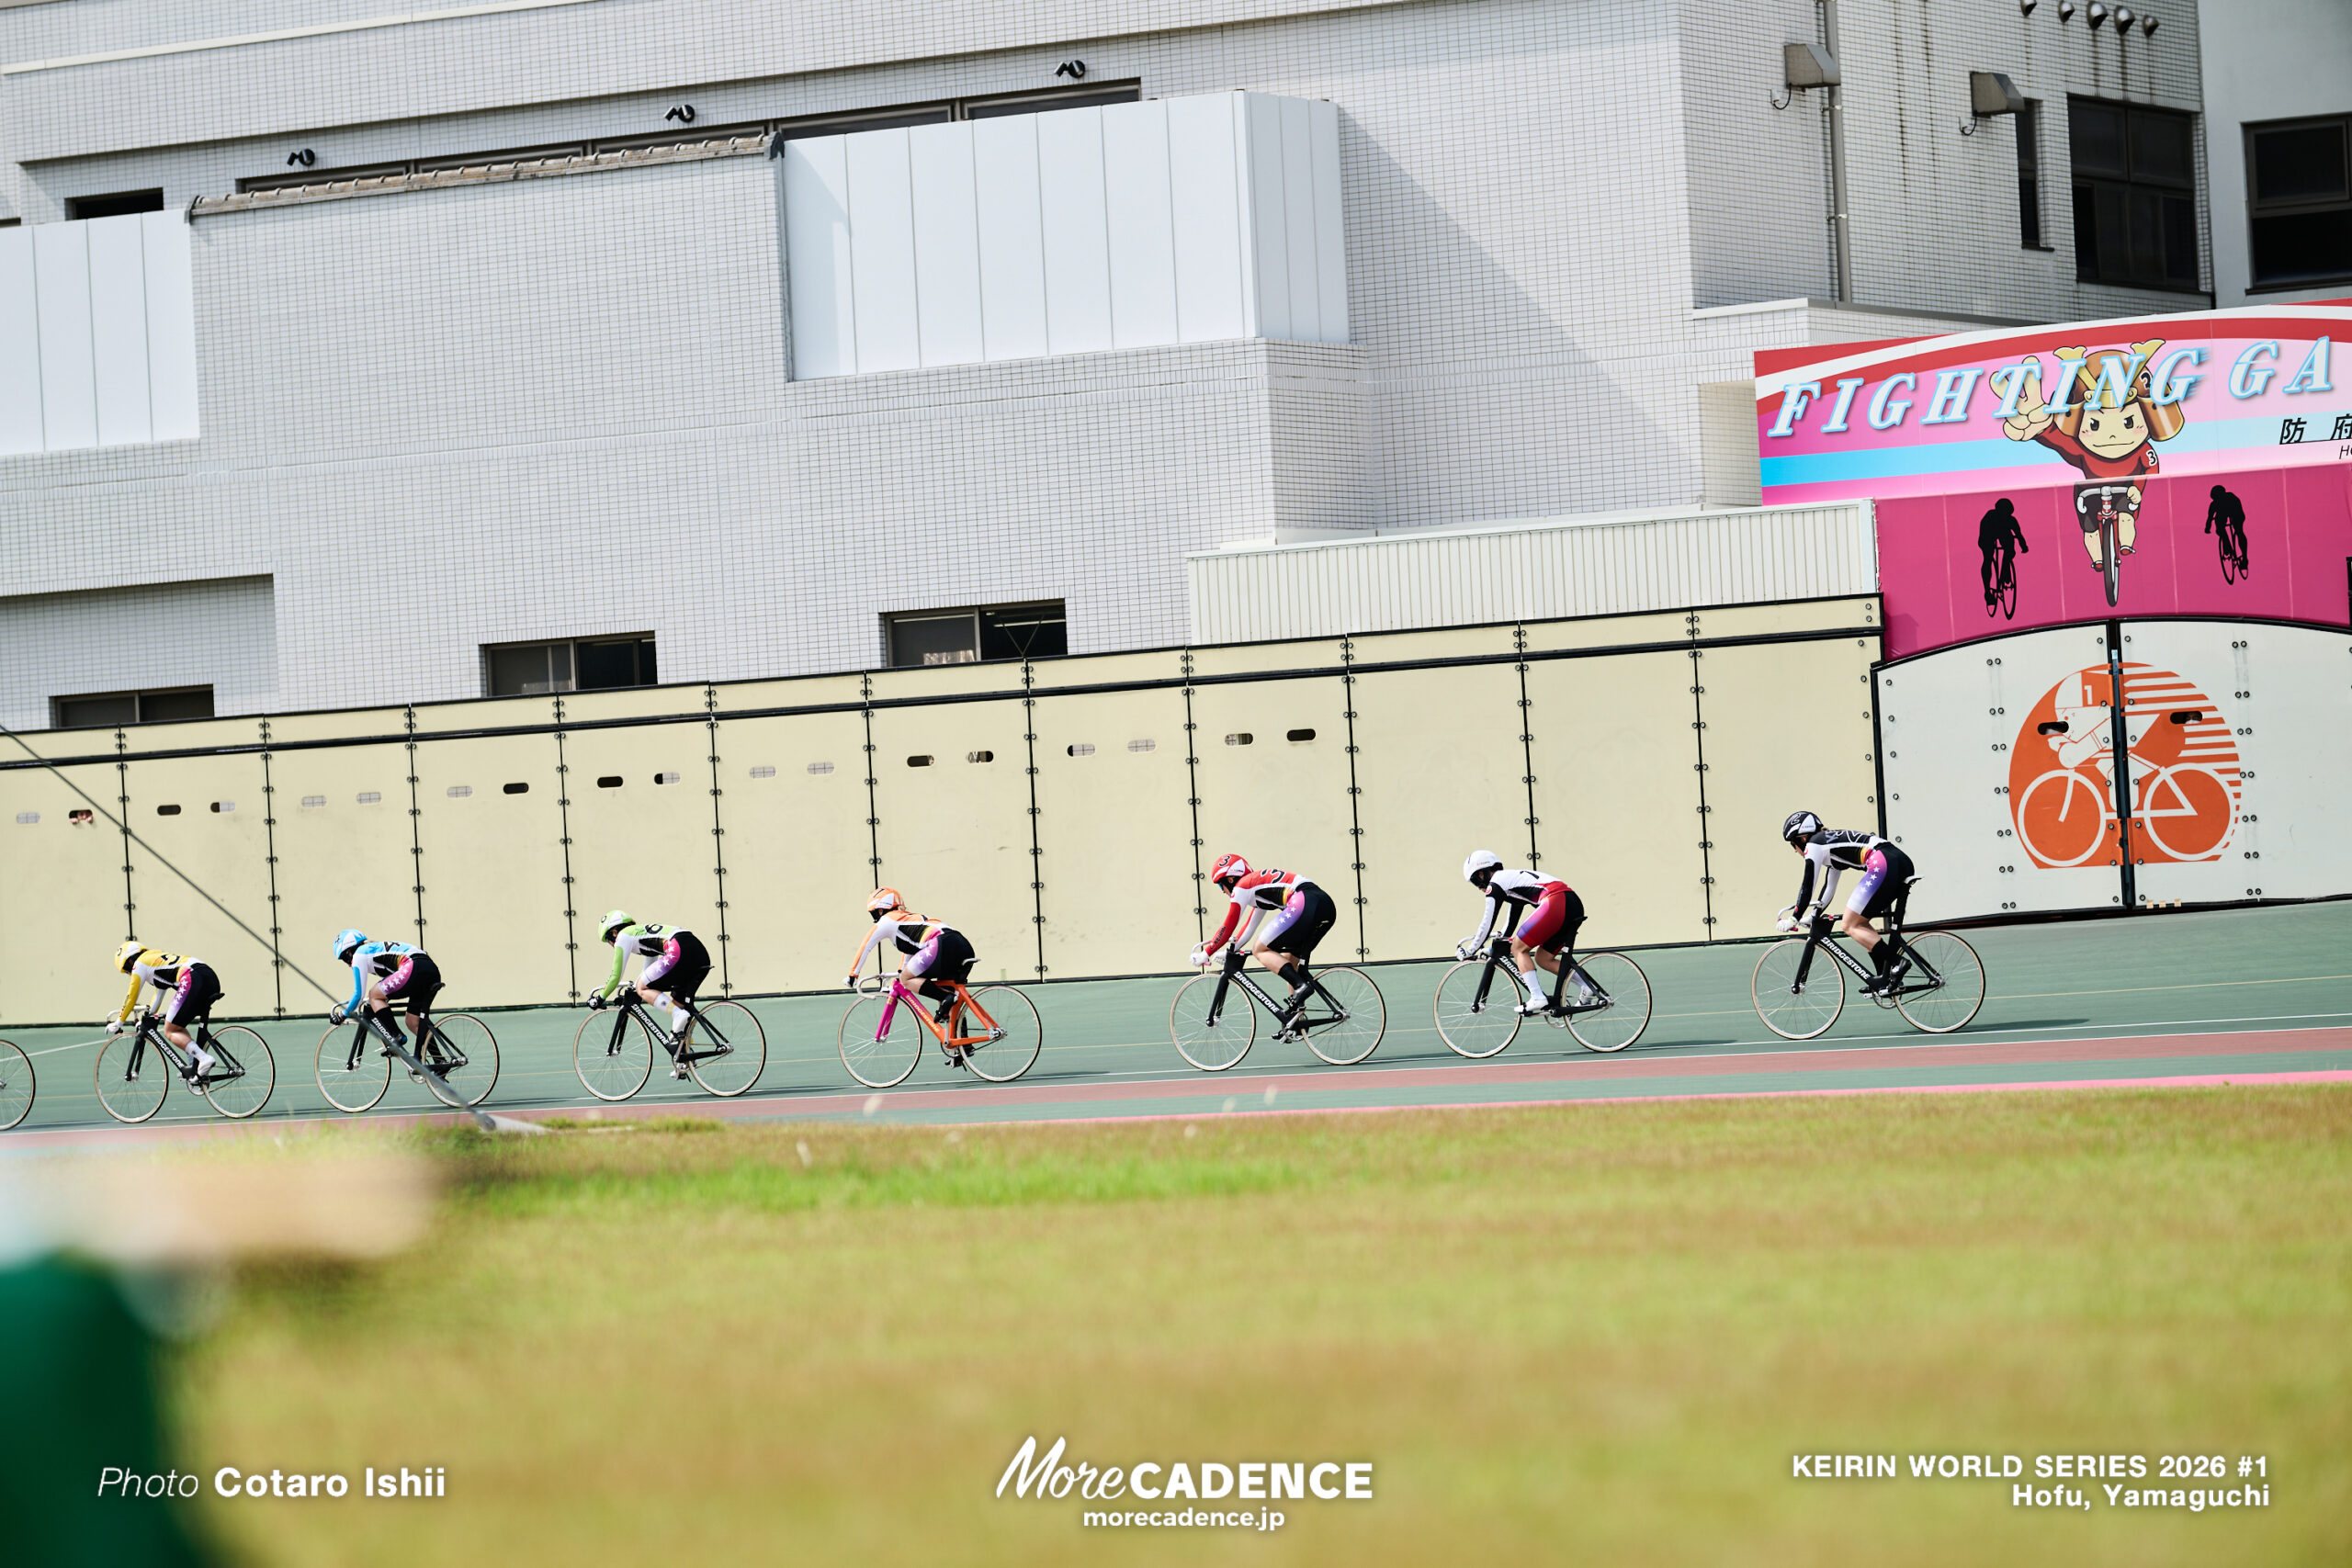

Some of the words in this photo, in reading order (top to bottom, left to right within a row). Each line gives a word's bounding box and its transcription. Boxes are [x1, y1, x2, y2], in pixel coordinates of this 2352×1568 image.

[1767, 347, 2205, 437] FIGHTING
[2146, 450, 2158, 466] 3
[2084, 684, 2093, 705] 1
[1218, 855, 1231, 867] 3
[1820, 936, 1871, 980] BRIDGESTONE
[1233, 971, 1280, 1013] BRIDGESTONE
[631, 1003, 670, 1045] BRIDGESTONE
[147, 1028, 185, 1069] BRIDGESTONE
